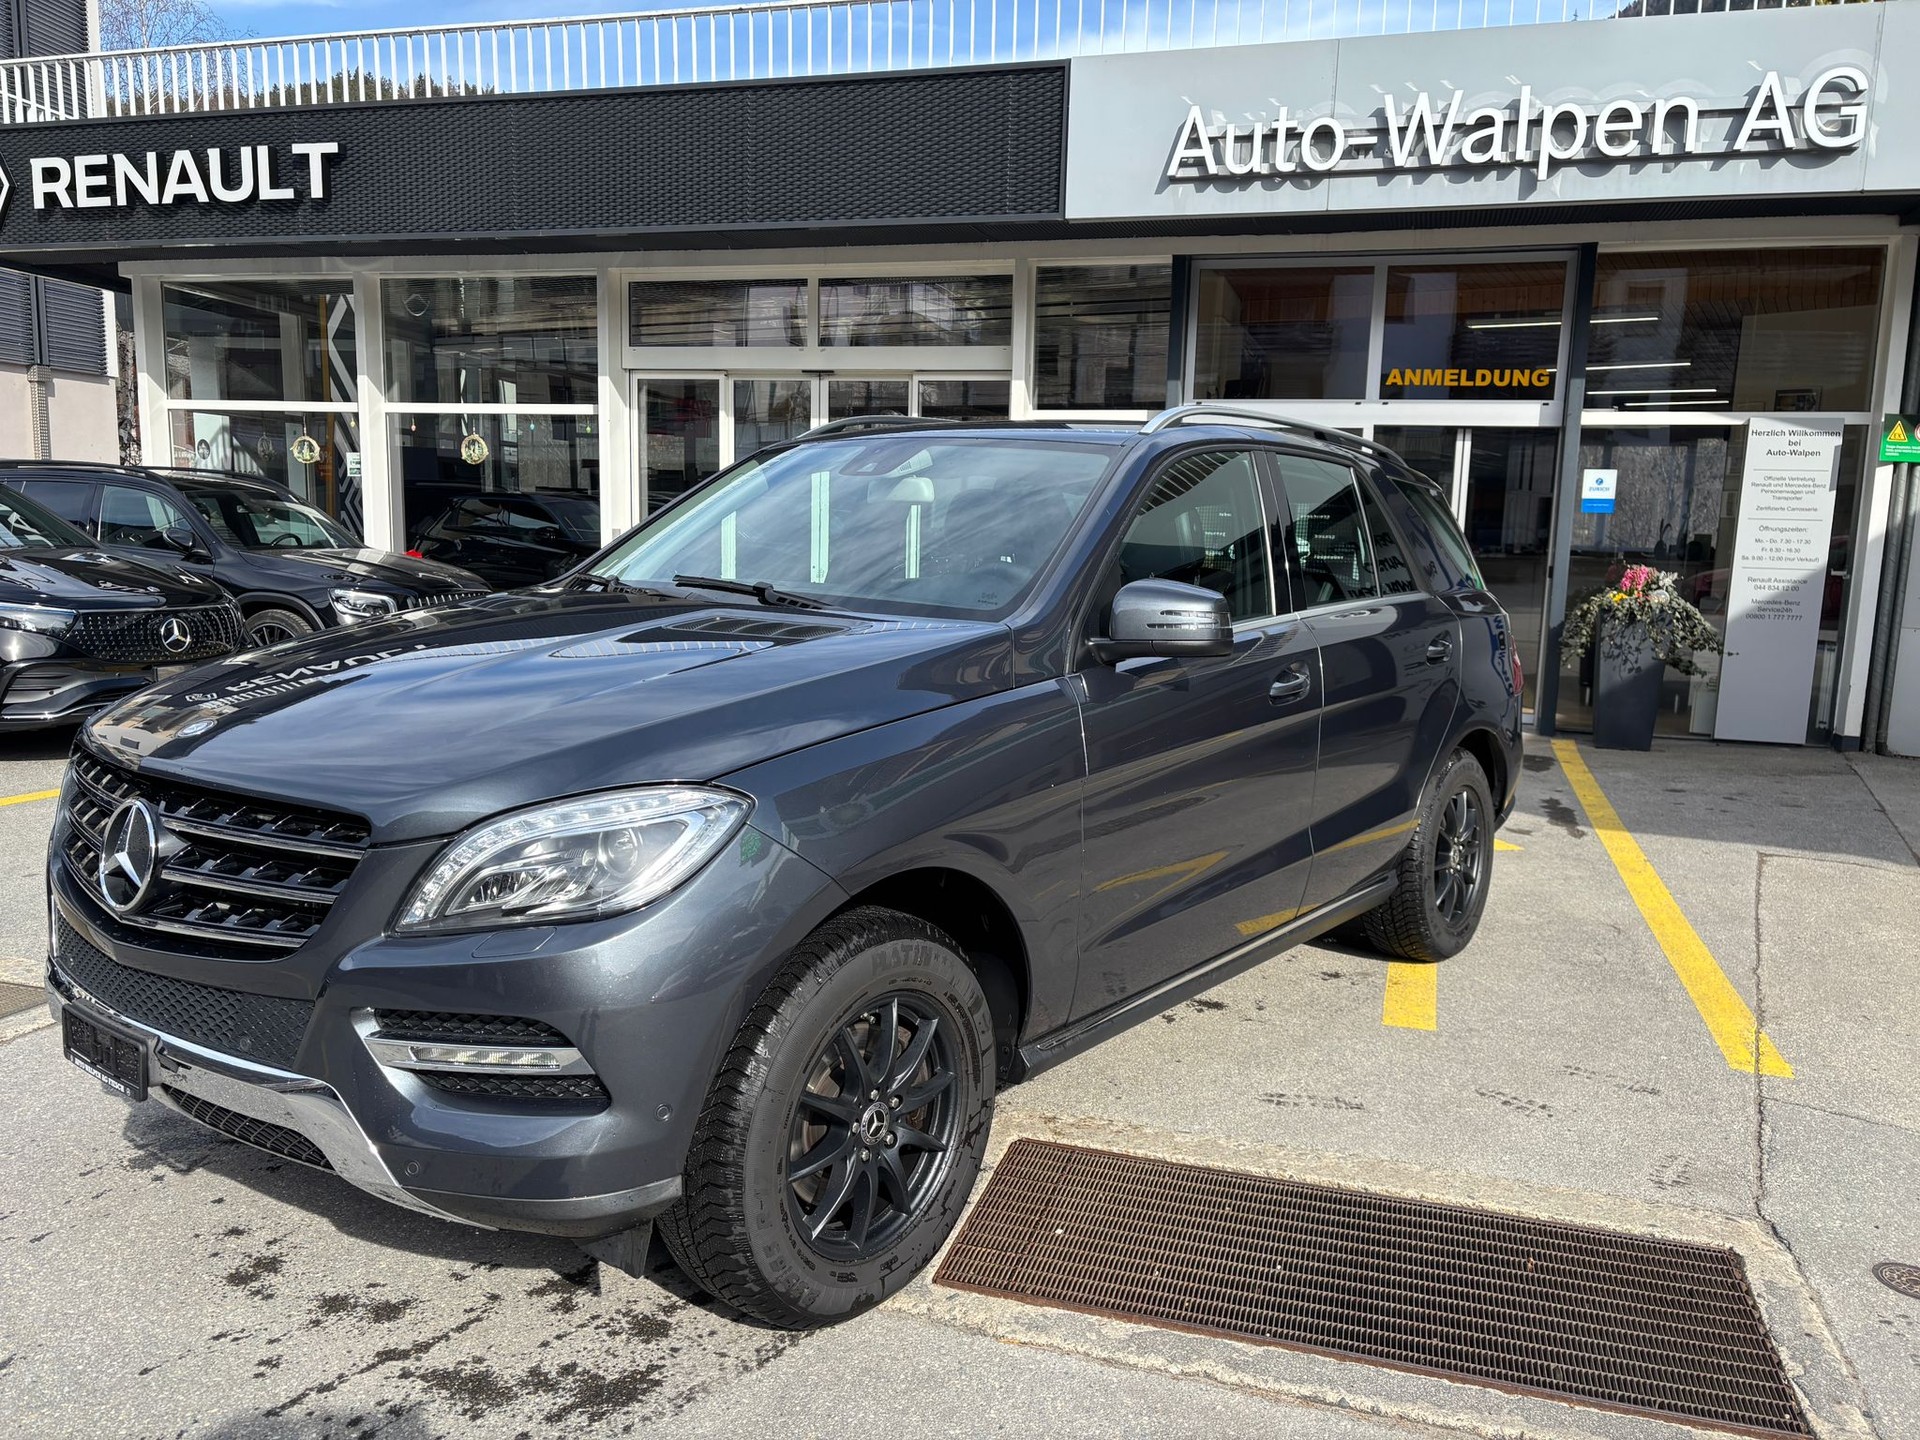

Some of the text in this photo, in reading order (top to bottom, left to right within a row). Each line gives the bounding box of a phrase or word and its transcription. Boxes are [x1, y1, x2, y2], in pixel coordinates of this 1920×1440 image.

[1167, 66, 1868, 181] Auto-Walpen AG
[30, 142, 339, 209] RENAULT
[1385, 368, 1550, 387] ANMELDUNG
[1751, 429, 1841, 437] Herzlich Willkommen
[1788, 439, 1801, 447] bei
[1766, 449, 1821, 458] Auto-Walpen
[1773, 577, 1808, 585] Assistance
[1751, 598, 1801, 606] Mercedes-Benz
